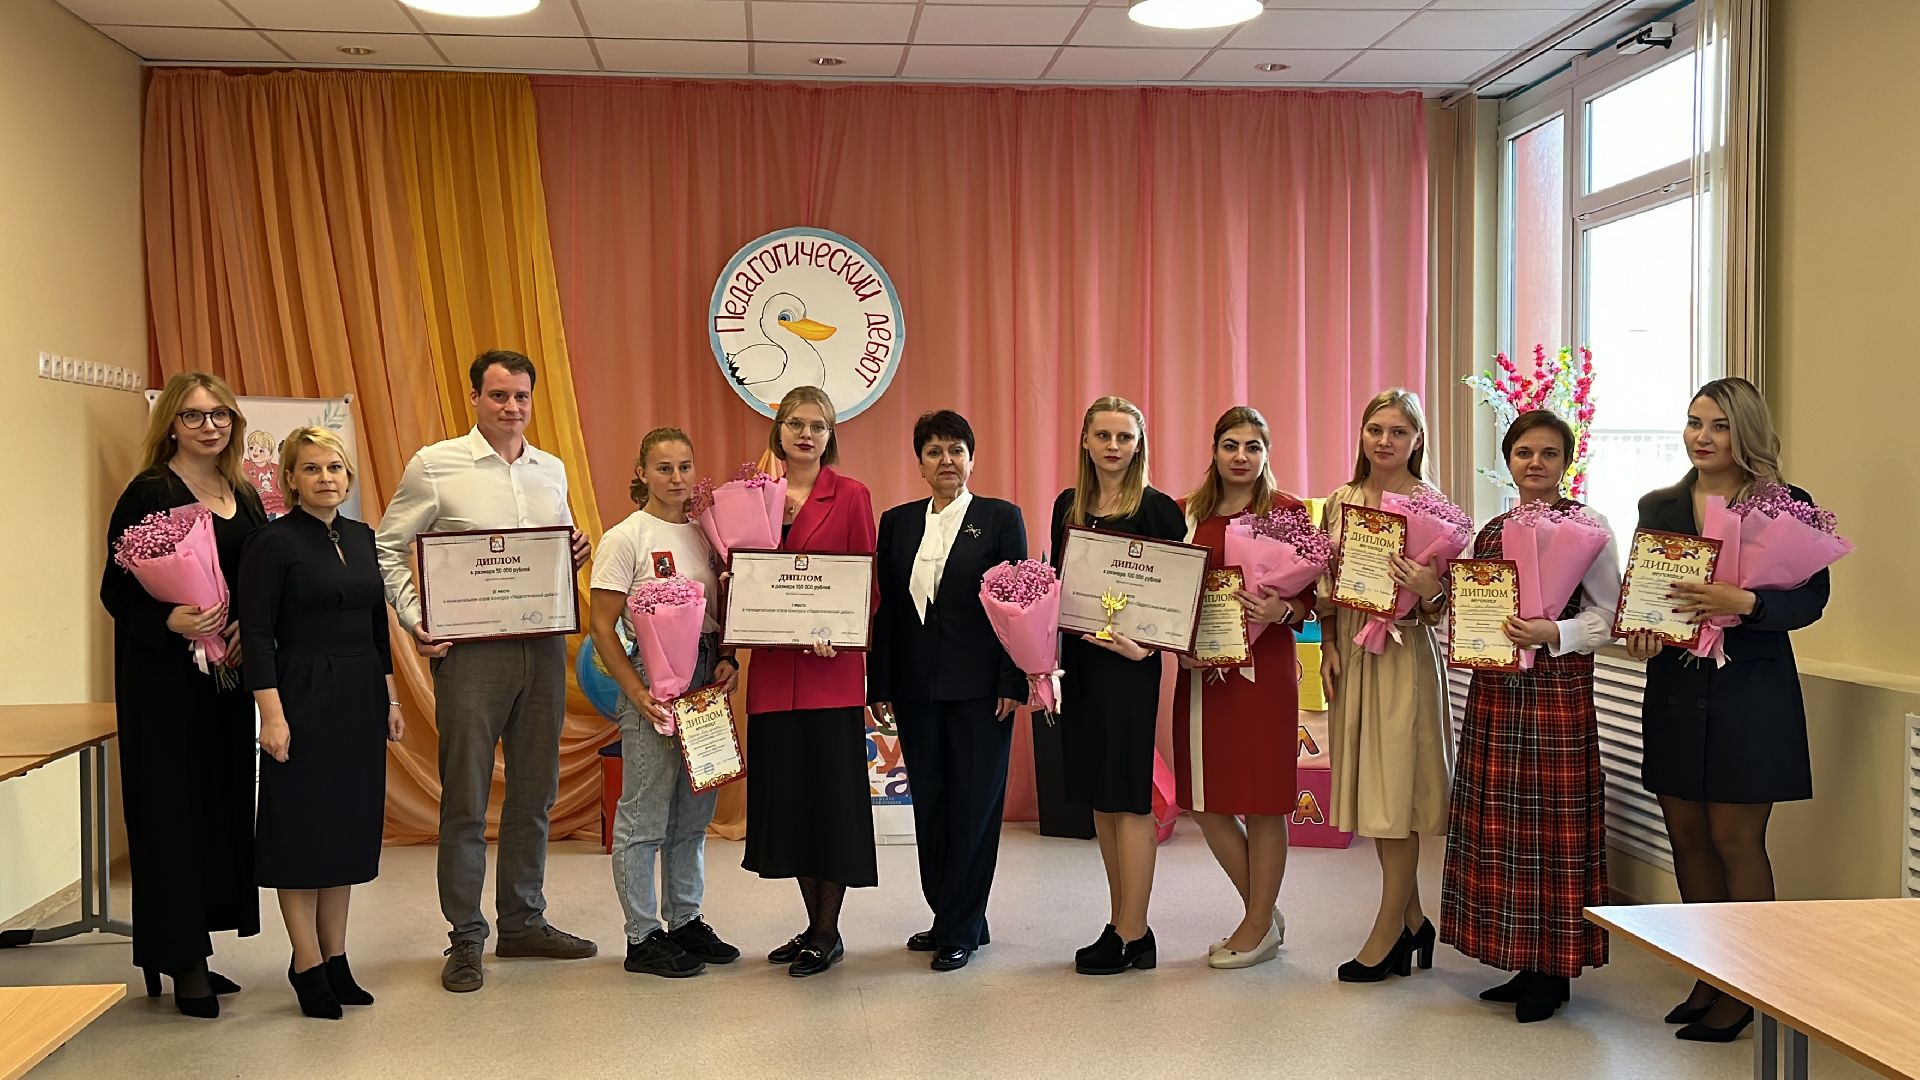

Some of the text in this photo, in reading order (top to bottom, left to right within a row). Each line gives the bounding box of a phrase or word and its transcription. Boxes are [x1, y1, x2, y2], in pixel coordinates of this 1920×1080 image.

[714, 241, 883, 334] Педагогический
[1351, 532, 1395, 549] ДИПЛОМ
[476, 556, 521, 567] ДИПЛОМ
[1111, 559, 1154, 573] ДИПЛОМ
[1640, 560, 1700, 576] ДИПЛОМ
[778, 574, 822, 582] ДИПЛОМ
[1460, 588, 1508, 598] ДИПЛОМ
[685, 710, 724, 730] ДИПЛОМ
